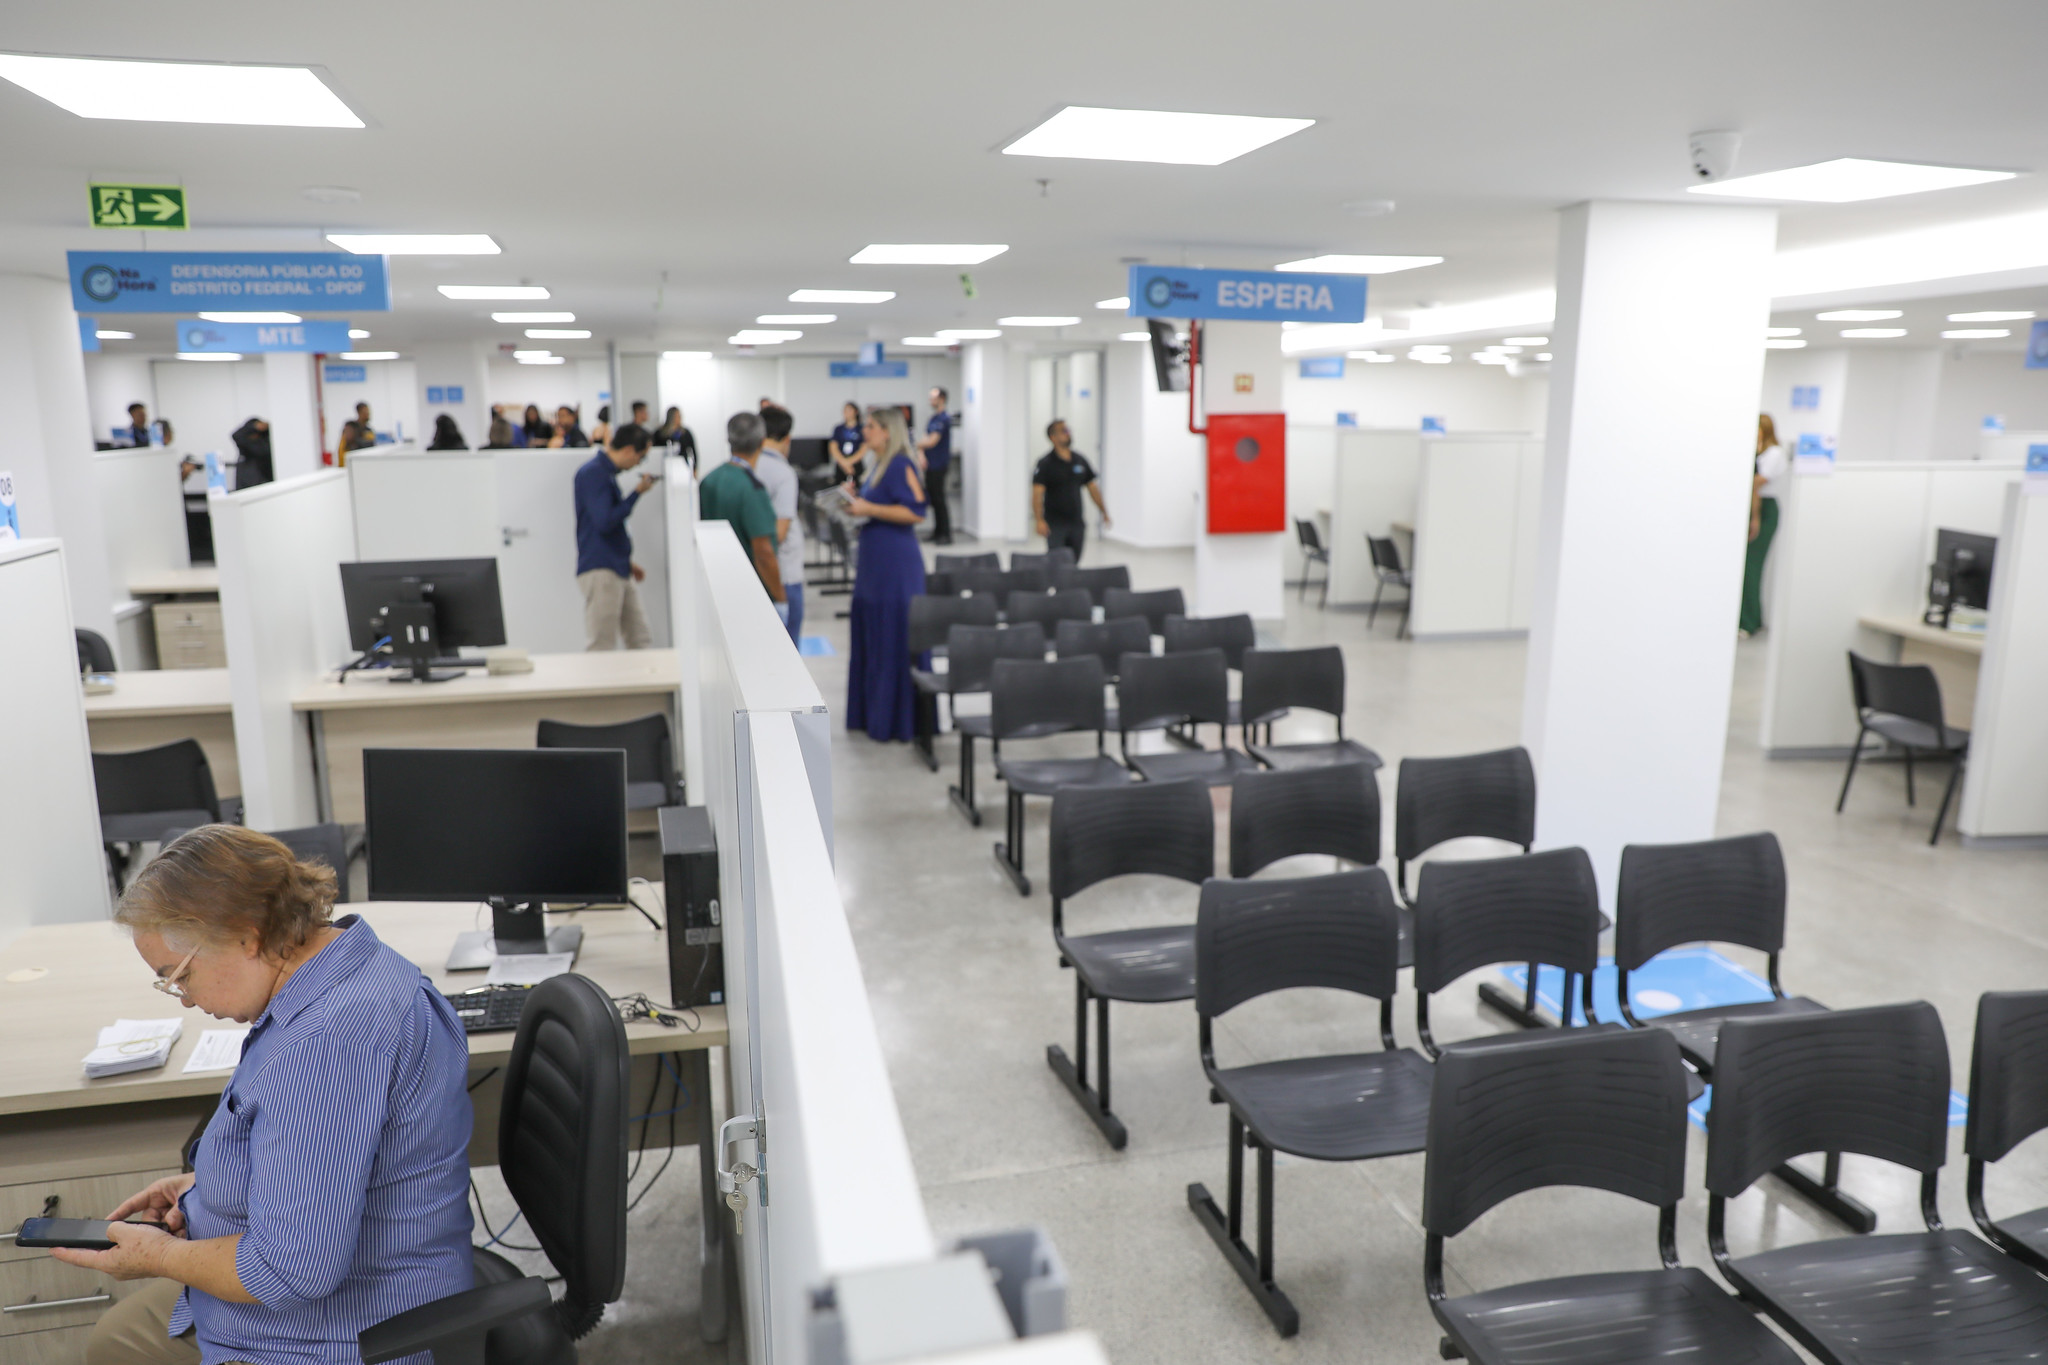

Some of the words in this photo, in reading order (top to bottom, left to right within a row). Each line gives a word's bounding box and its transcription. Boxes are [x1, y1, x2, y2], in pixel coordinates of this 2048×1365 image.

[171, 264, 269, 278] DEFENSORIA
[272, 261, 338, 278] PÚBLICA
[340, 264, 363, 278] DO
[170, 281, 242, 295] DISTRITO
[245, 281, 313, 295] FEDERAL
[325, 281, 366, 295] DPDF
[1217, 280, 1334, 311] ESPERA
[258, 327, 305, 345] MTE
